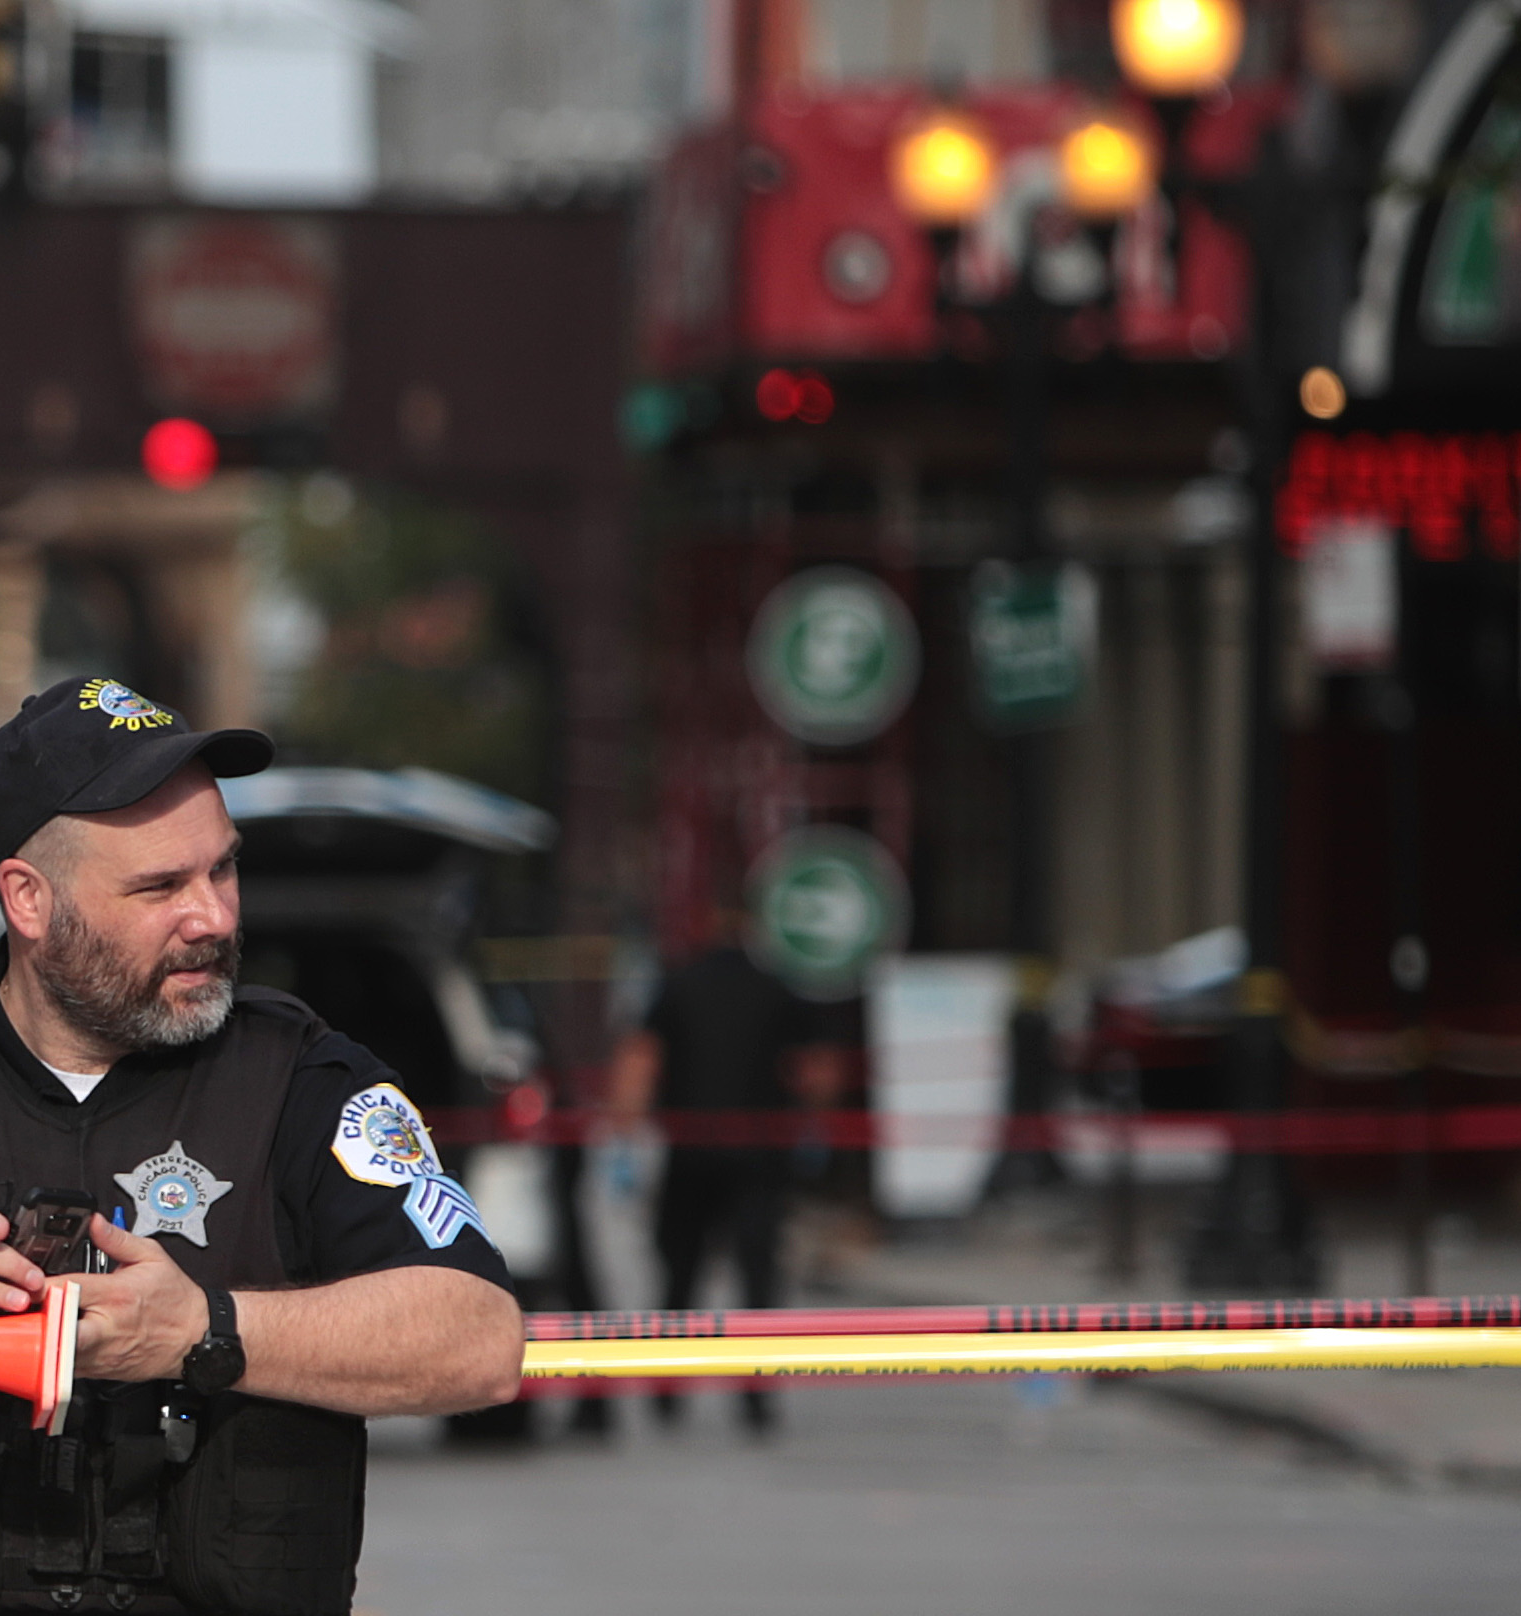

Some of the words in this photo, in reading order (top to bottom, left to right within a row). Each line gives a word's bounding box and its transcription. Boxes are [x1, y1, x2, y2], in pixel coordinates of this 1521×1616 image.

[341, 1094, 421, 1139] CHICAGO
[138, 1165, 178, 1201] CHICAGO
[183, 1171, 208, 1208] POLICE
[145, 1156, 205, 1174] SERGEANT
